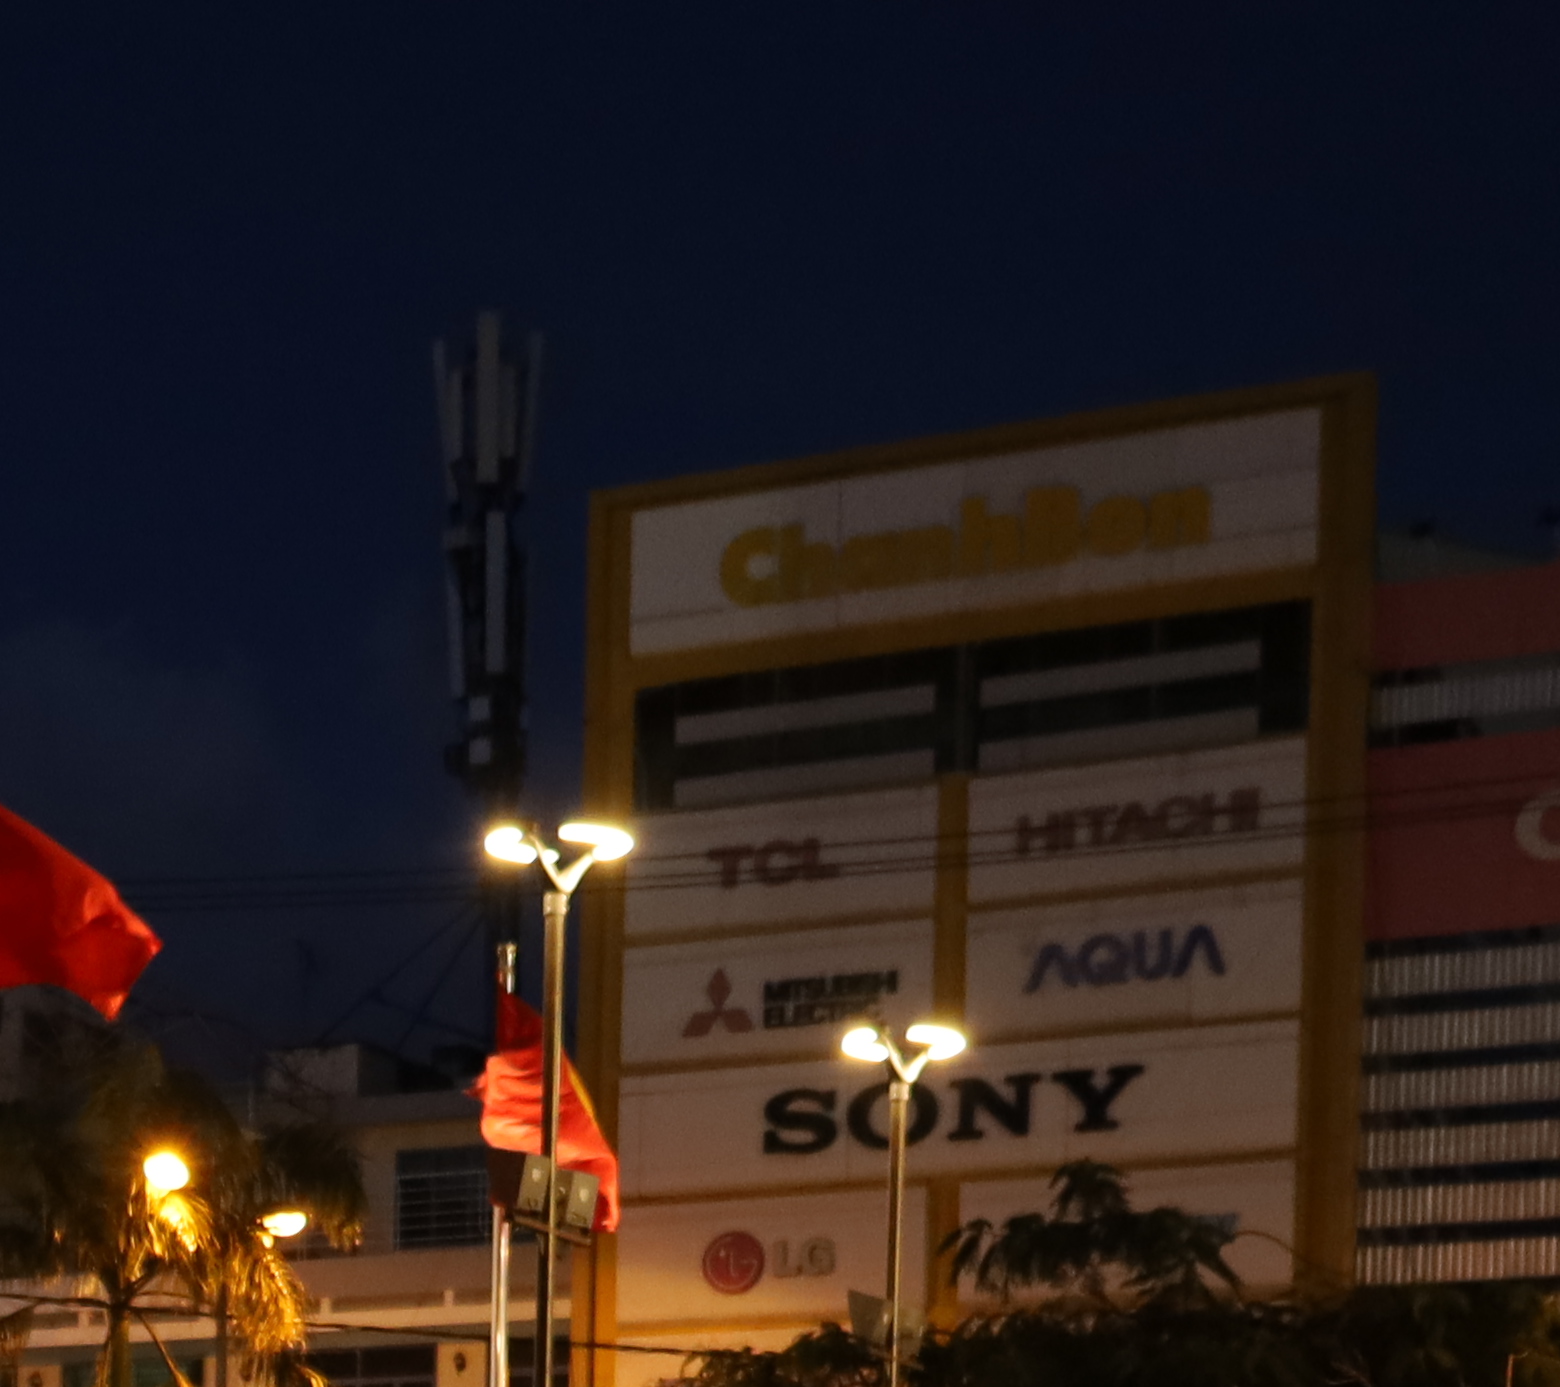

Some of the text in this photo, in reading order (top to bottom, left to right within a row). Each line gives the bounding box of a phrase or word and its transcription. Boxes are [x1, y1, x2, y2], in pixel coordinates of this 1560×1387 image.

[1016, 788, 1260, 854] HITACHI
[707, 837, 839, 888] TCL
[1023, 925, 1225, 994] AQUA
[763, 1065, 1144, 1155] SONY
[772, 1238, 836, 1278] LG
